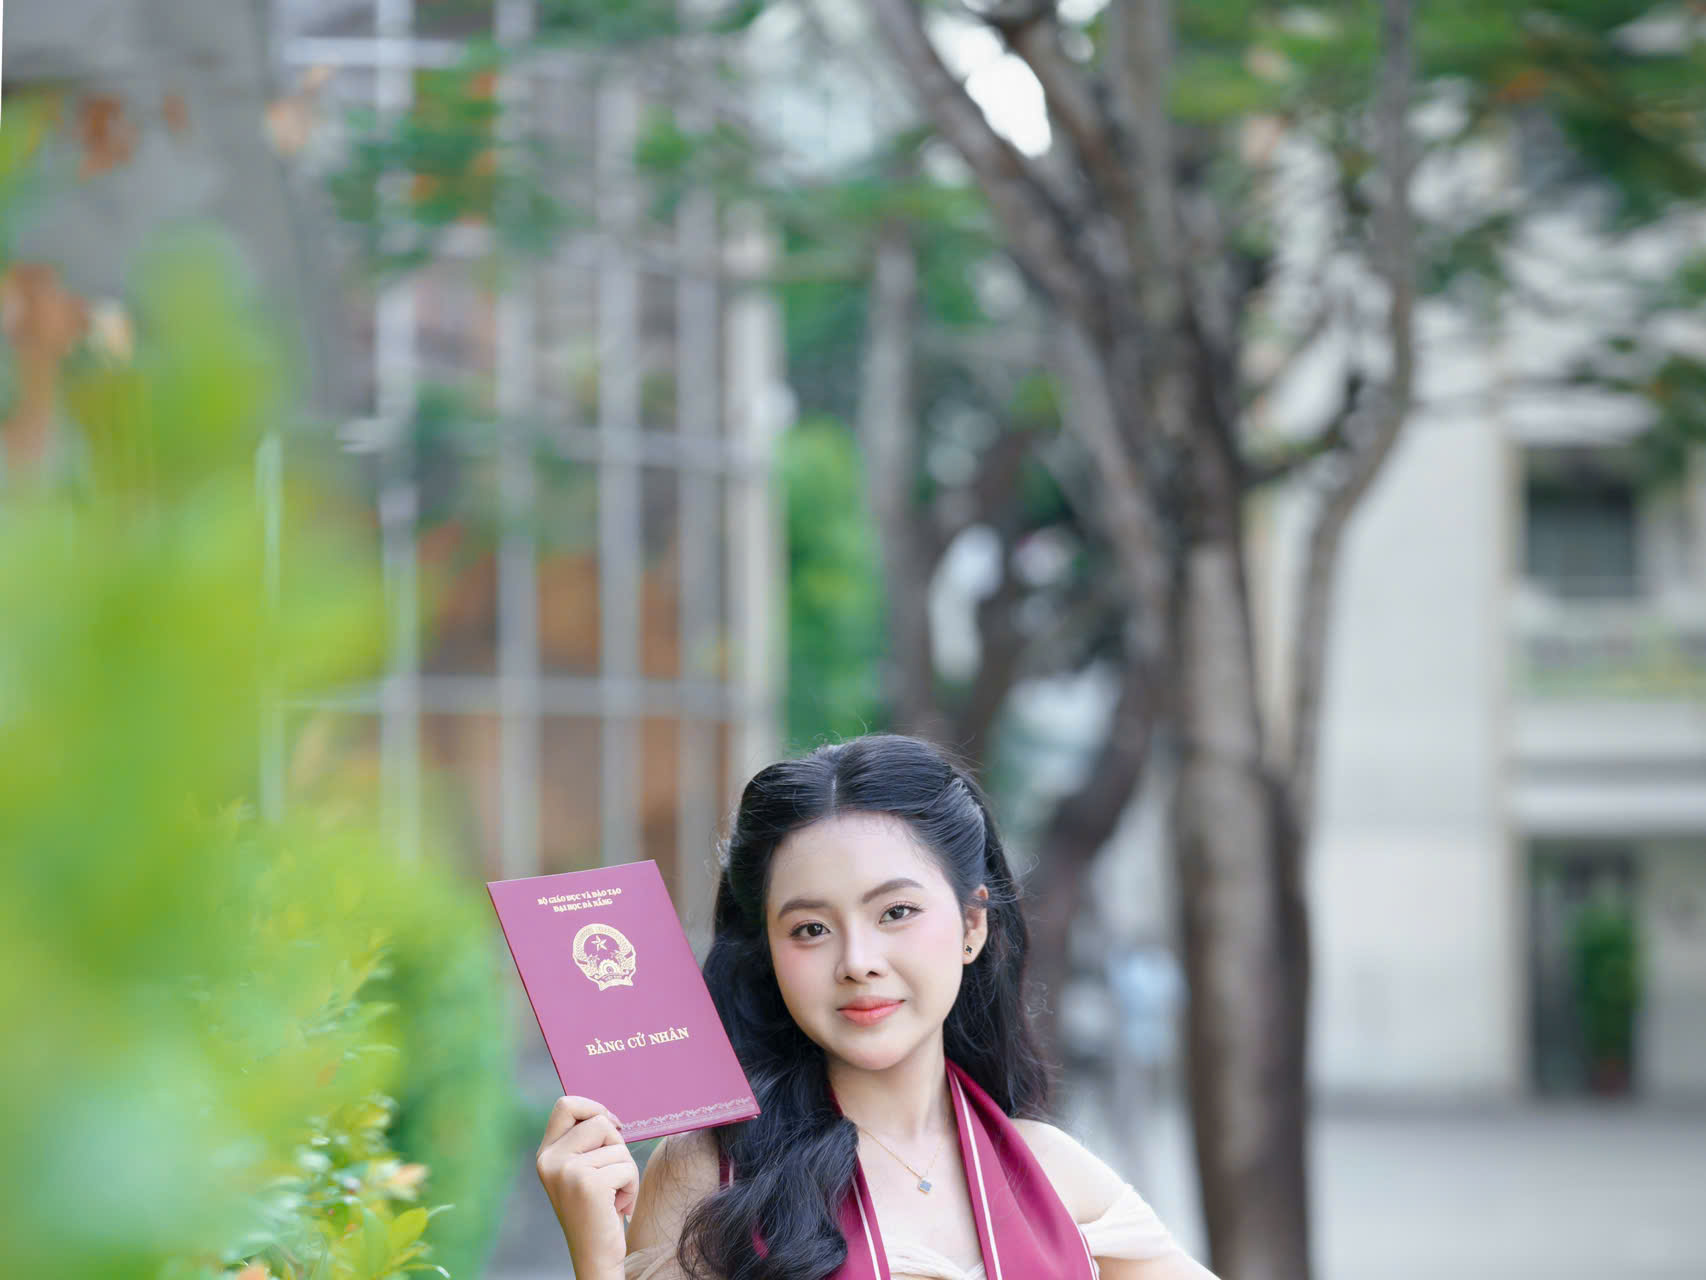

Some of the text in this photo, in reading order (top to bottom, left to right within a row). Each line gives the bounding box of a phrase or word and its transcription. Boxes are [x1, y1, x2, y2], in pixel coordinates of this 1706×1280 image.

[537, 896, 548, 906] BỘ
[549, 895, 566, 904] GIÁO
[581, 891, 592, 899] VÀ
[592, 889, 607, 898] ĐÀO
[607, 888, 622, 896] TẠO
[553, 905, 567, 913] ĐẠI
[567, 903, 582, 911] HỌC
[583, 900, 593, 908] ĐÀ
[586, 1027, 690, 1056] BẰNG CỬ NHÂN
